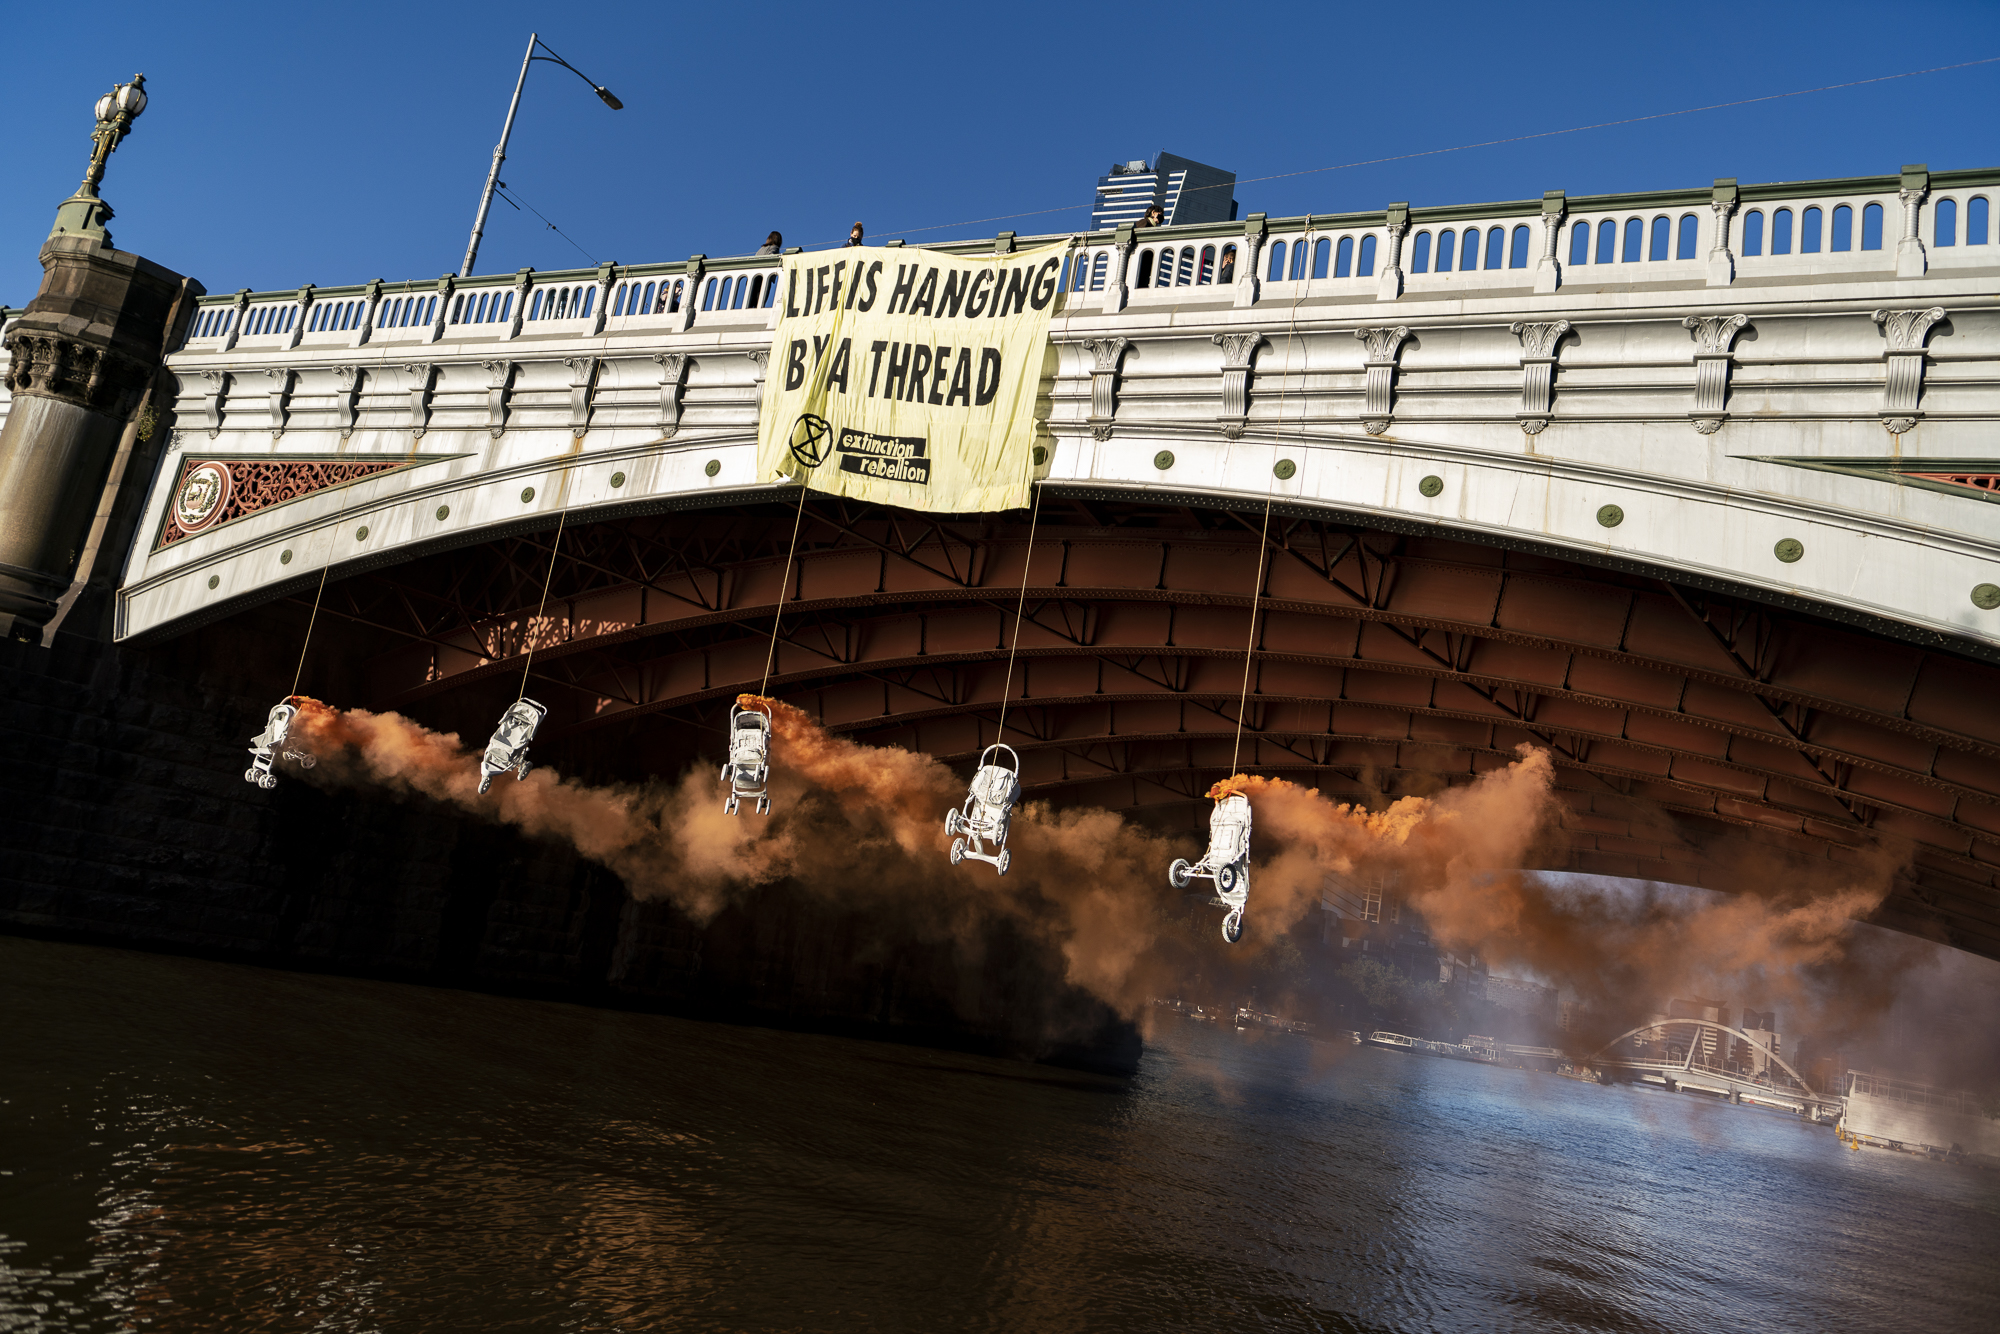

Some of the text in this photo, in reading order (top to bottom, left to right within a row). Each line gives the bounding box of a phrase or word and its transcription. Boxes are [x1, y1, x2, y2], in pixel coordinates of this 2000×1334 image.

[786, 256, 1060, 319] LIFE IS HANGING
[785, 333, 1001, 407] BY A THREAD
[842, 434, 915, 457] extinction
[859, 457, 927, 482] rebellion
